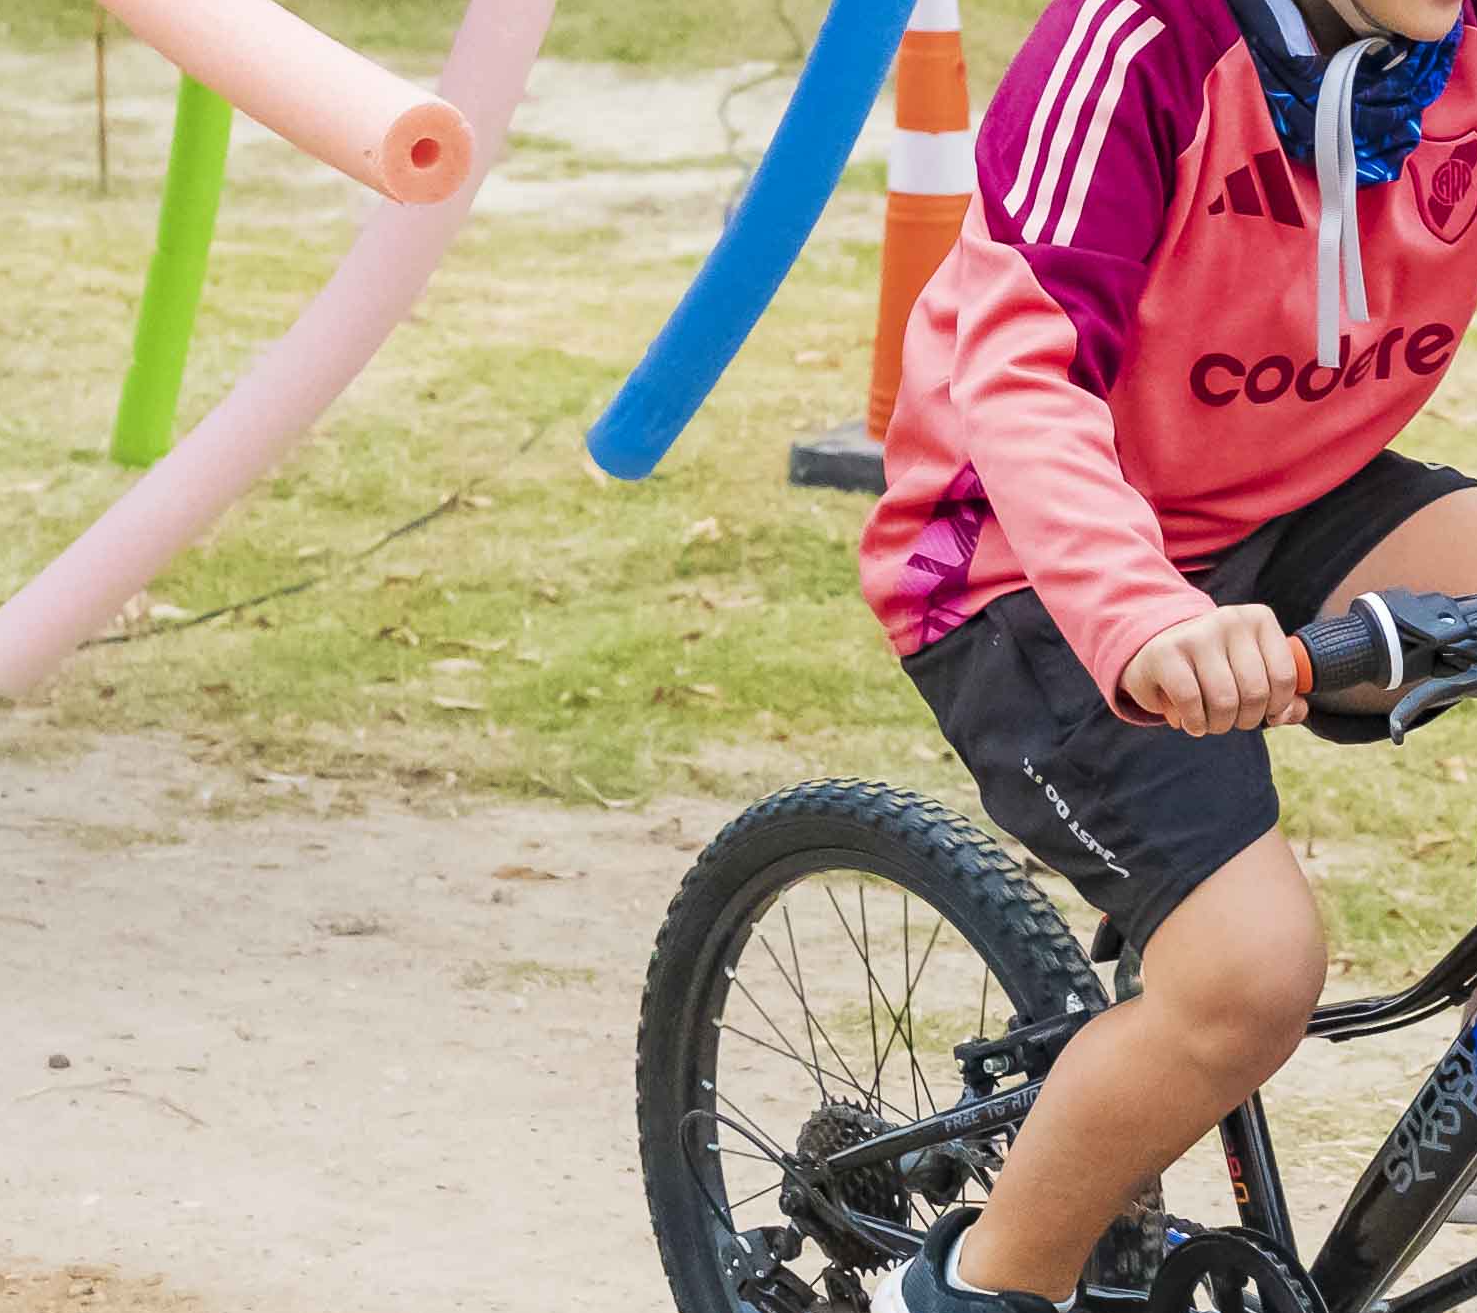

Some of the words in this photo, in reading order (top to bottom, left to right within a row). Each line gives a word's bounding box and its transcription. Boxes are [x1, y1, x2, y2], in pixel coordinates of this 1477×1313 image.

[1189, 323, 1455, 408] codere
[1045, 783, 1071, 820] DO
[1068, 820, 1117, 862] JUST
